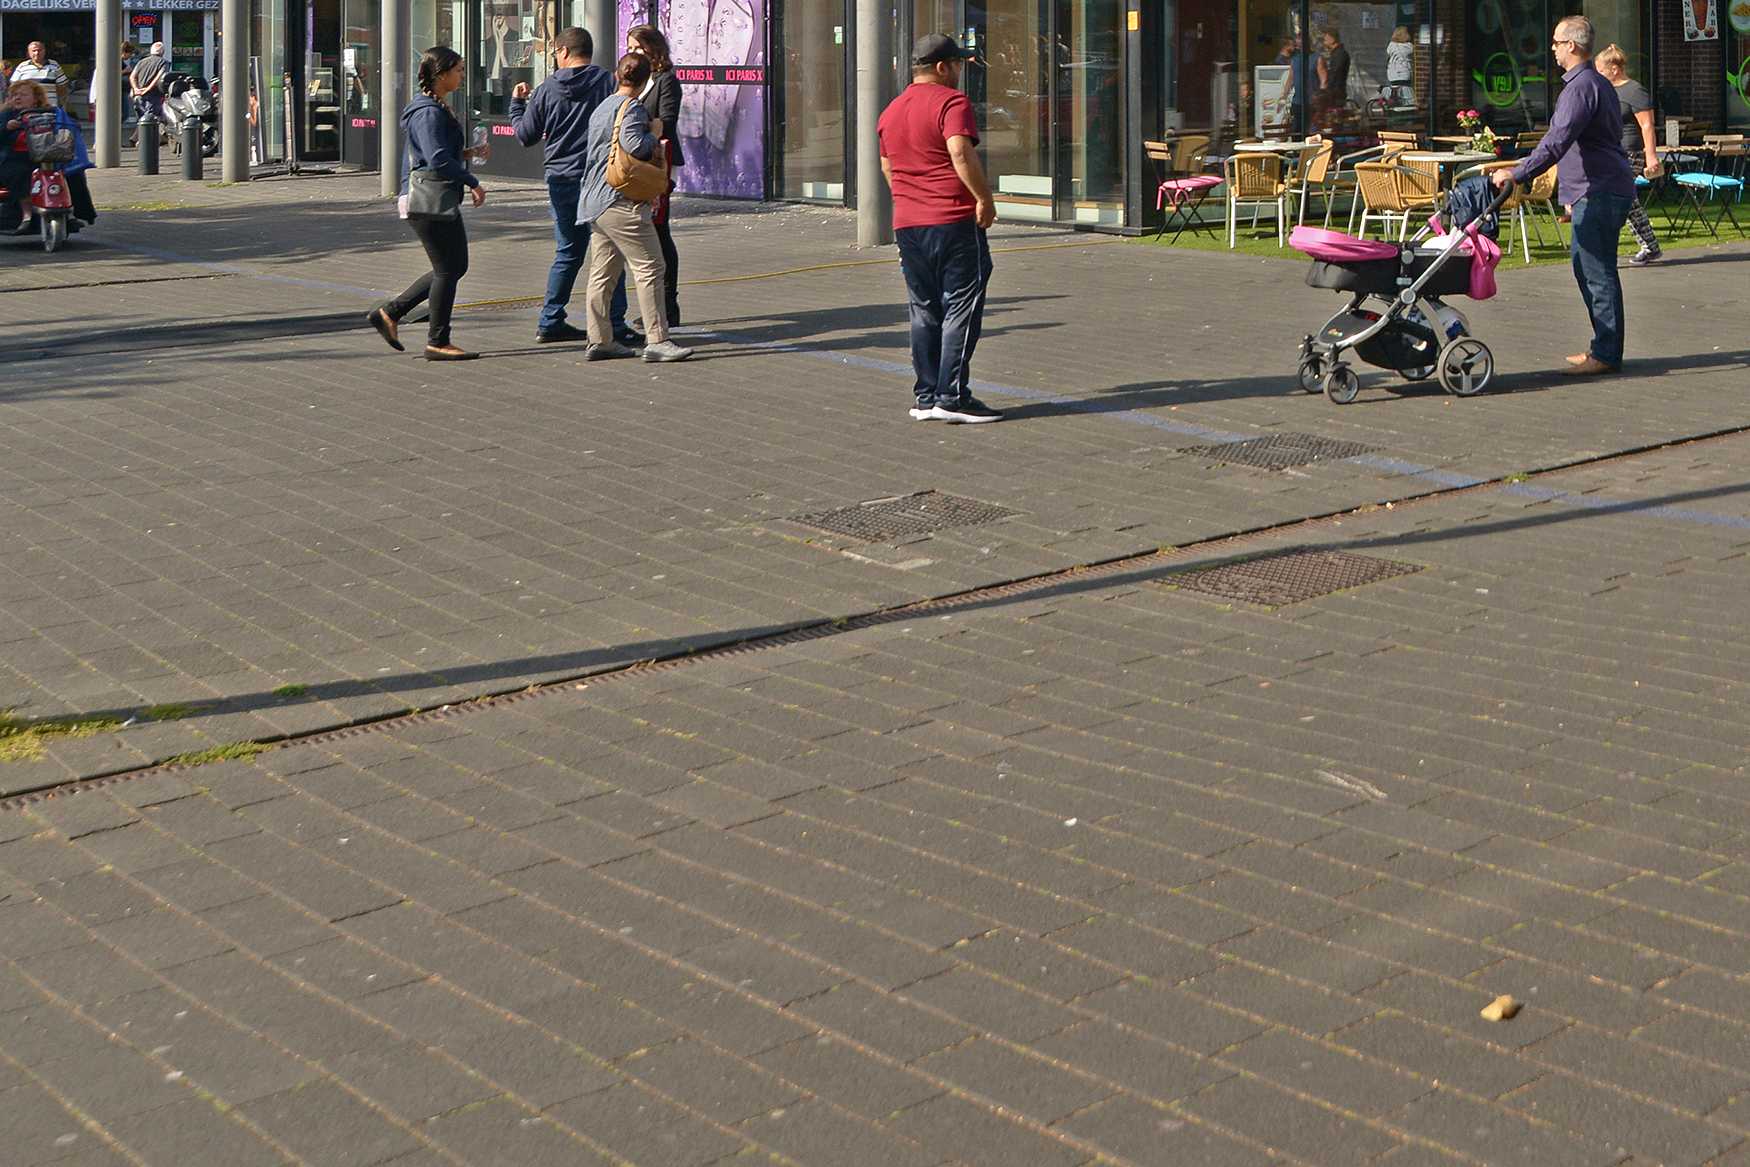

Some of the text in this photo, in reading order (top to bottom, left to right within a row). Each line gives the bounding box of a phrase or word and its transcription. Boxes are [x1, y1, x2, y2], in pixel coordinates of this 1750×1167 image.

[1, 0, 97, 9] DAGELIJKS VER
[150, 0, 193, 9] LEKKER
[131, 15, 157, 25] OPEN
[686, 70, 705, 81] PARIS
[705, 70, 714, 81] XL
[726, 69, 736, 81] ICI
[737, 70, 756, 81] PARIS
